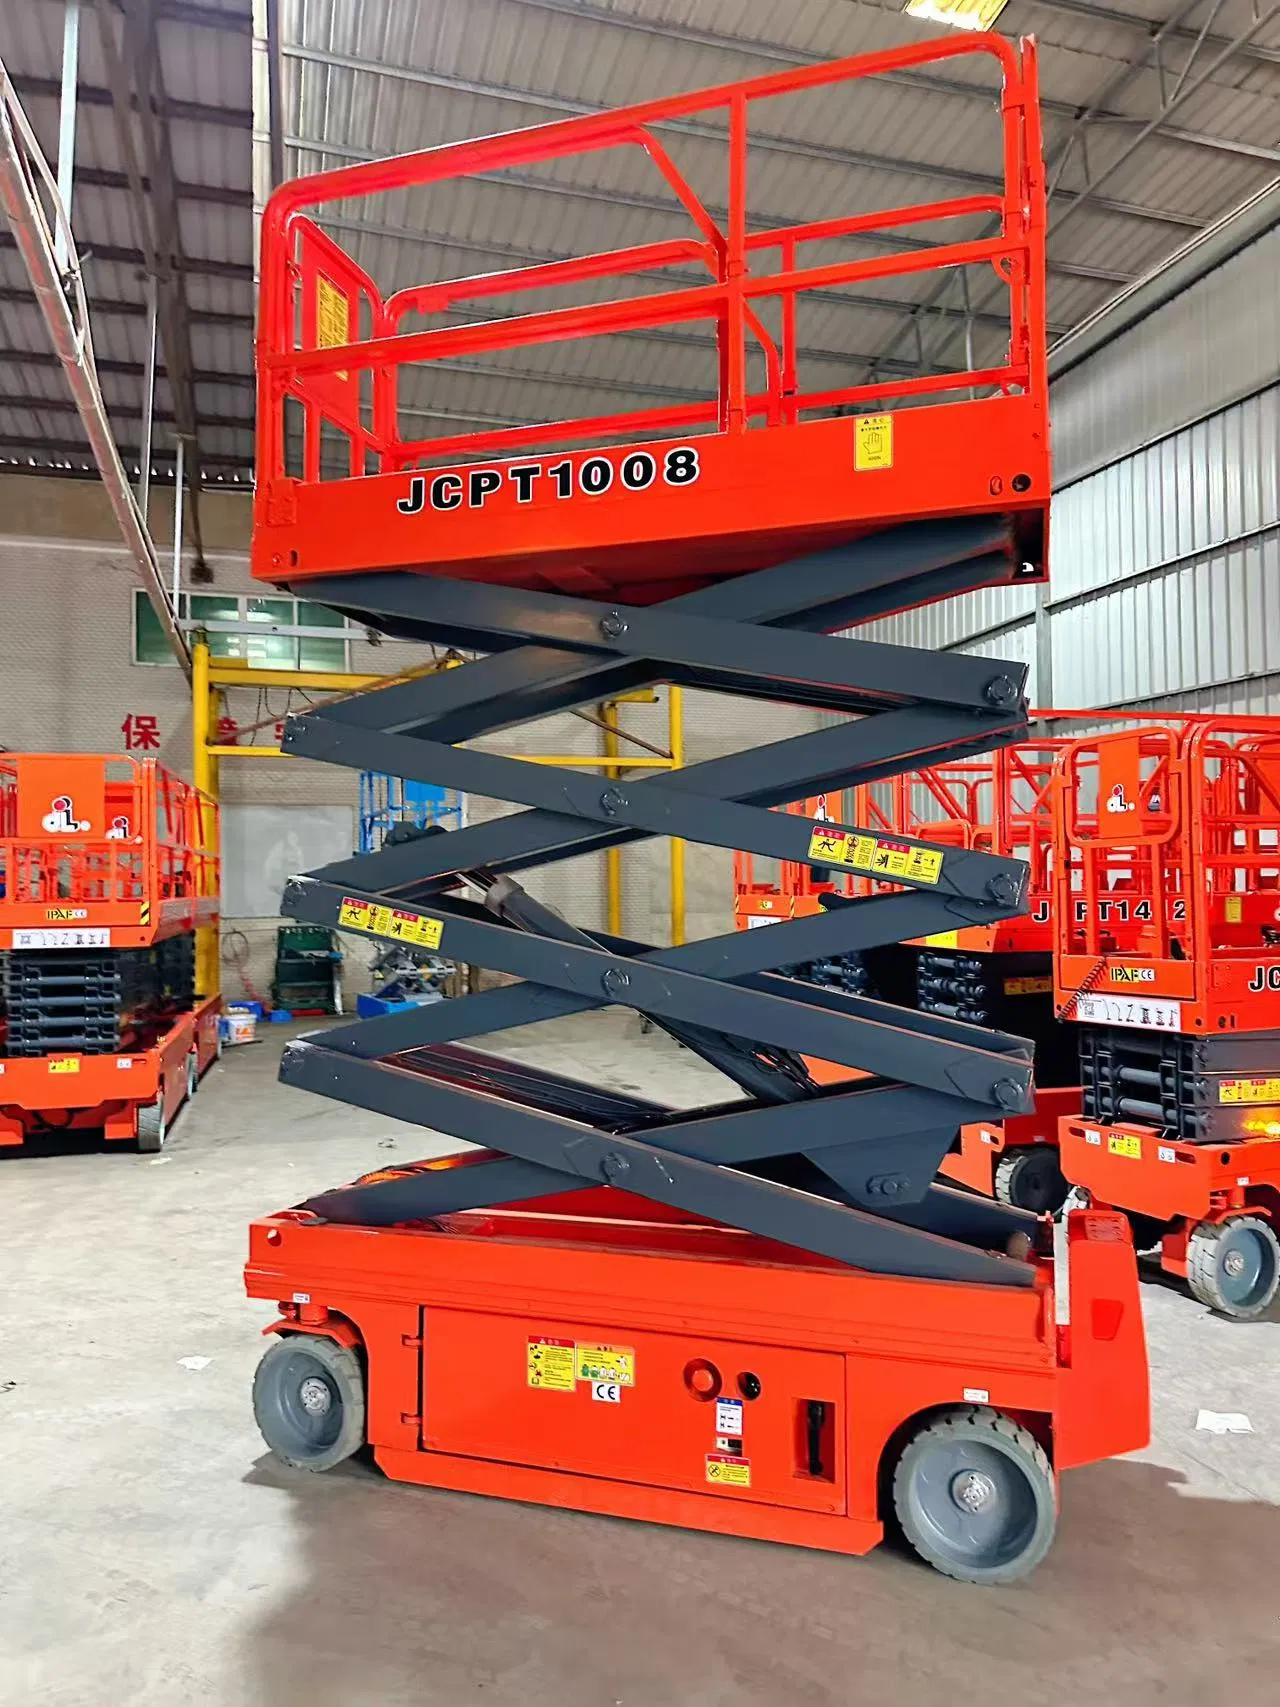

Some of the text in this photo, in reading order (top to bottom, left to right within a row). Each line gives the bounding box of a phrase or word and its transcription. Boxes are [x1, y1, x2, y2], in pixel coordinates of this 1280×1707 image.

[397, 447, 699, 514] JCPT1008
[1032, 899, 1186, 923] JPT142
[1111, 965, 1153, 981] IPAF CE
[596, 1384, 616, 1400] CE
